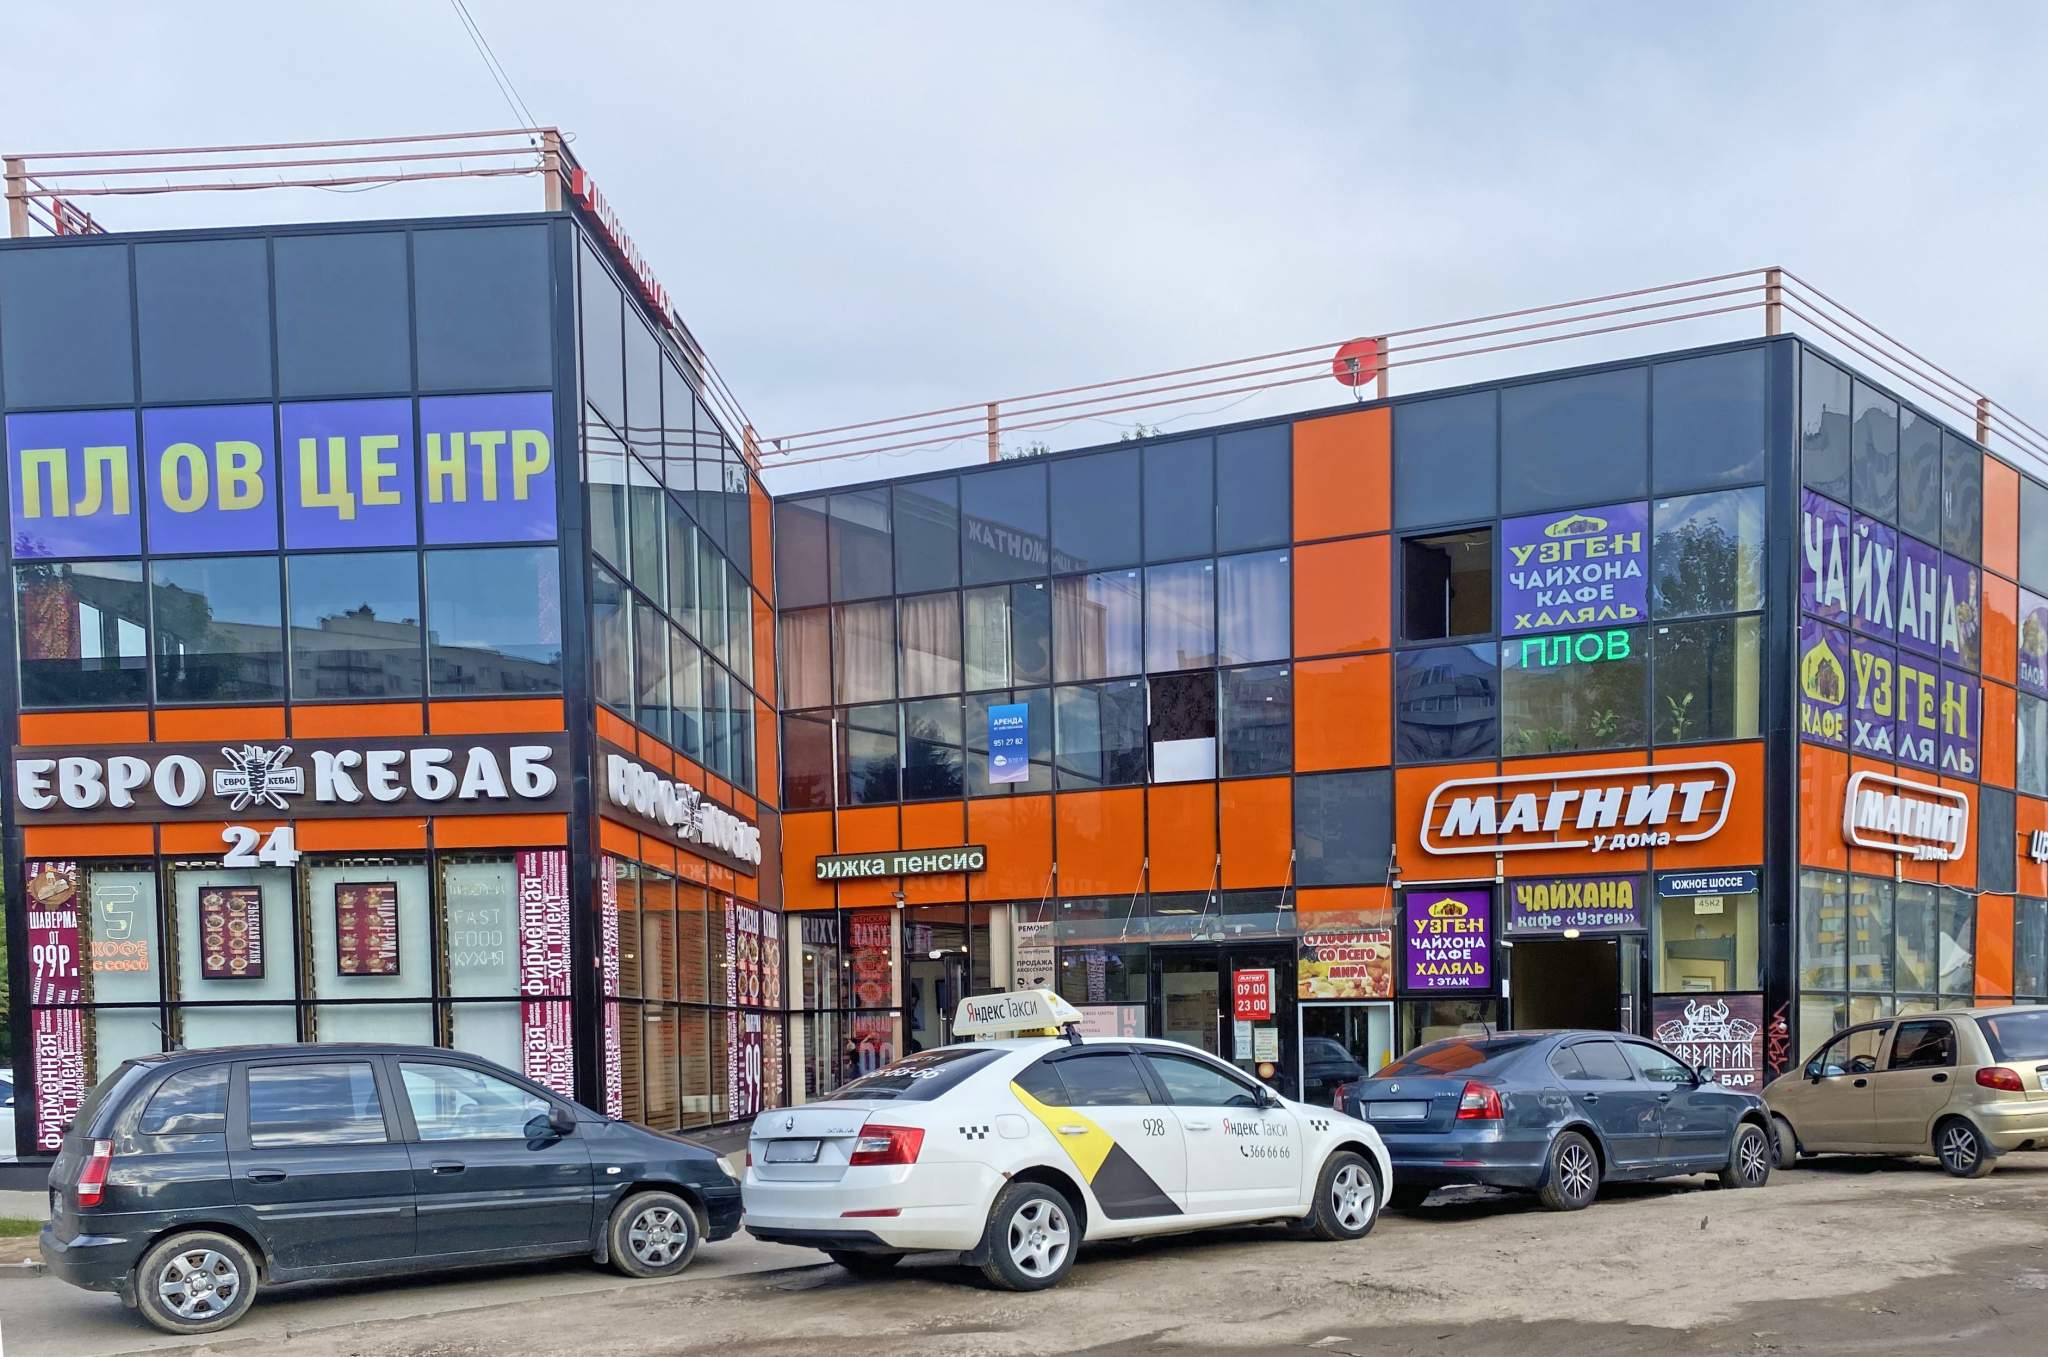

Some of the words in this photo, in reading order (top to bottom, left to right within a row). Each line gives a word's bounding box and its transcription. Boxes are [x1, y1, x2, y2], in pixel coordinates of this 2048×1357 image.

[20, 440, 265, 518] ПЛОВ
[300, 429, 551, 520] ЦЕНТР
[1509, 531, 1641, 567] УЗГЕН
[1509, 559, 1642, 591] ЧАЙХОНА
[1804, 512, 1959, 654] ЧАЙХАНА
[1536, 584, 1615, 607] КАФЕ
[1513, 603, 1639, 630] ХАЛЯЛЬ
[1522, 630, 1631, 668] ПЛОВ
[1851, 648, 1968, 739] УЗГЕН
[994, 717, 1023, 726] АРЕНДА
[1801, 702, 1845, 743] КАФЕ
[1854, 718, 1975, 775] ХАЛЯЛЬ
[16, 755, 206, 812] ЕВРО
[313, 746, 558, 803] КЕБАБ
[1440, 780, 1715, 838] МАГНИТ
[1854, 790, 1962, 843] МАГНИТ
[222, 826, 302, 868] 24
[1592, 836, 1608, 853] у
[1610, 831, 1671, 850] дома
[893, 852, 984, 873] пенсио
[1672, 879, 1707, 890] ЮЖНОЕ
[1709, 877, 1743, 888] ШОССЕ
[1517, 880, 1633, 912] ЧАЙХАНА
[29, 911, 78, 929] ШАВЕРМА
[455, 909, 500, 925] FAST
[1413, 918, 1484, 933] УЗГЕН
[1518, 912, 1561, 930] кафе
[1567, 912, 1635, 926] «Узген»
[49, 931, 59, 945] ОТ
[377, 899, 396, 959] ШАВЕРМА
[455, 931, 503, 947] FOOD
[521, 878, 549, 996] фирменная
[561, 899, 571, 973] мексиканская
[92, 940, 148, 958] КОФЕ
[1411, 935, 1486, 949] ЧАЙХОНА
[33, 944, 78, 977] 99Р.
[547, 951, 562, 978] хот
[1319, 949, 1336, 962] СО
[1338, 948, 1376, 962] ВСЕГО
[1426, 949, 1471, 960] КАФЕ
[1328, 965, 1367, 979] МИРА
[1416, 962, 1484, 975] ХАЛЯЛЬ
[1238, 984, 1250, 995] 09
[1253, 984, 1266, 994] 00
[967, 1003, 1005, 1023] Яндекс
[1005, 998, 1037, 1017] Такси
[1238, 1000, 1251, 1011] 23
[1254, 1000, 1266, 1010] 00
[1722, 1075, 1755, 1086] БАР
[39, 1035, 65, 1149] фирменная
[63, 1105, 78, 1123] от
[1143, 1118, 1165, 1136] 928
[1223, 1118, 1259, 1137] Яндекс
[1260, 1119, 1287, 1136] Такси
[1250, 1145, 1265, 1158] 366
[1267, 1145, 1279, 1158] 66
[1280, 1145, 1290, 1158] 66
